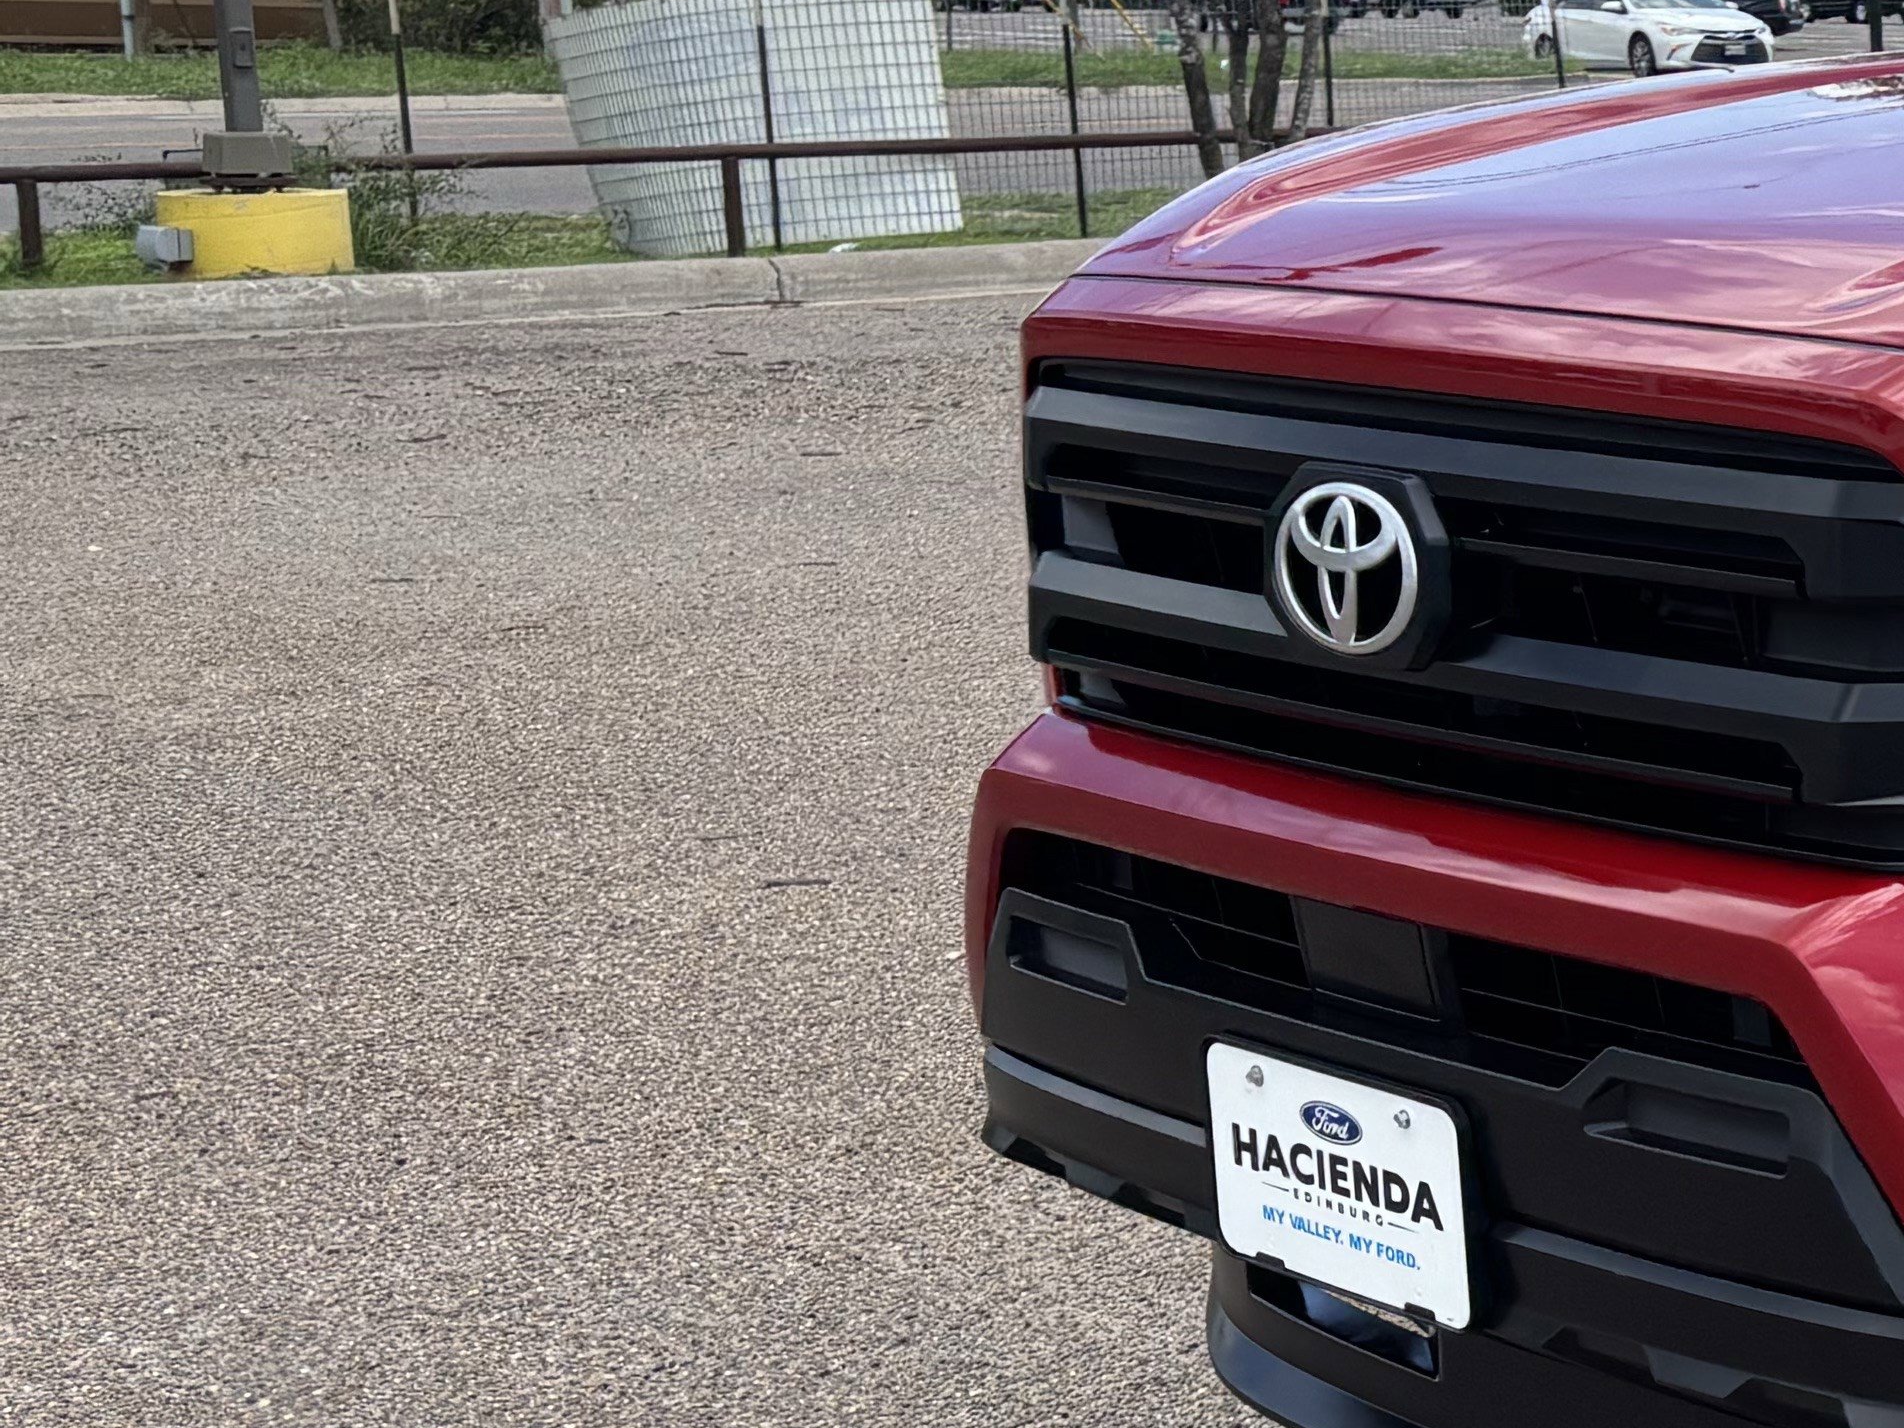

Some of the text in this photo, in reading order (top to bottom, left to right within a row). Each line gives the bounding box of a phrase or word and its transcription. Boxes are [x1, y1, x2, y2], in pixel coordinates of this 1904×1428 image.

[1311, 1106, 1350, 1141] Ford
[1231, 1122, 1444, 1232] HACIENDA
[1293, 1188, 1384, 1227] EDINBURG
[1262, 1205, 1421, 1271] MY VALLEY. MY FORD.
